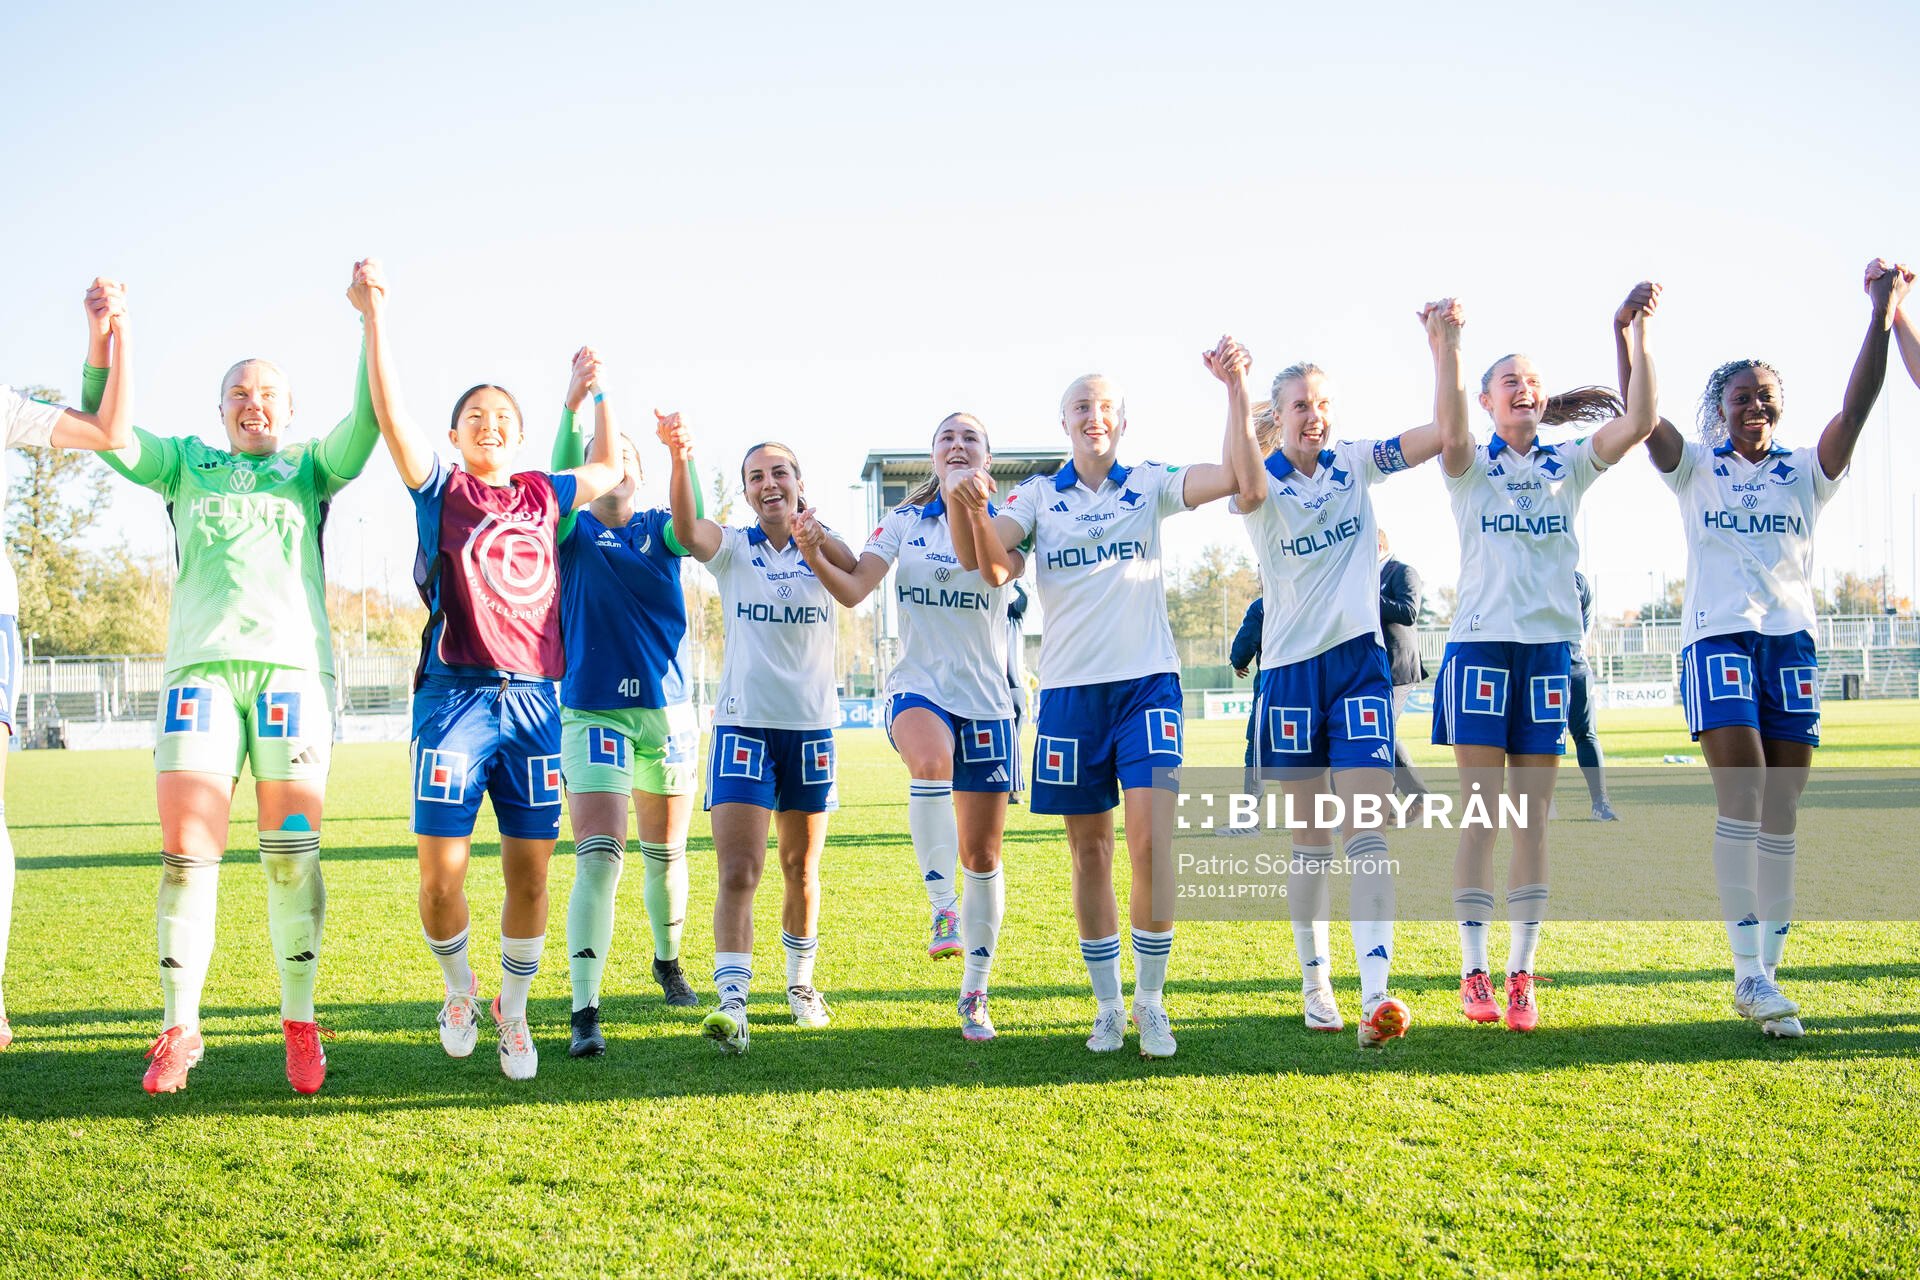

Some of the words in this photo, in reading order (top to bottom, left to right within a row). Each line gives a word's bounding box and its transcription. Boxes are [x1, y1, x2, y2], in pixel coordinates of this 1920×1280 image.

[1075, 511, 1115, 522] stadium
[1704, 511, 1801, 535] HOLMEN
[1280, 515, 1362, 557] HOLMEN
[925, 551, 957, 564] stadiu
[1047, 541, 1147, 570] HOLMEN
[898, 585, 990, 610] HOLMEN
[737, 602, 829, 624] HOLMEN
[617, 678, 641, 698] 40
